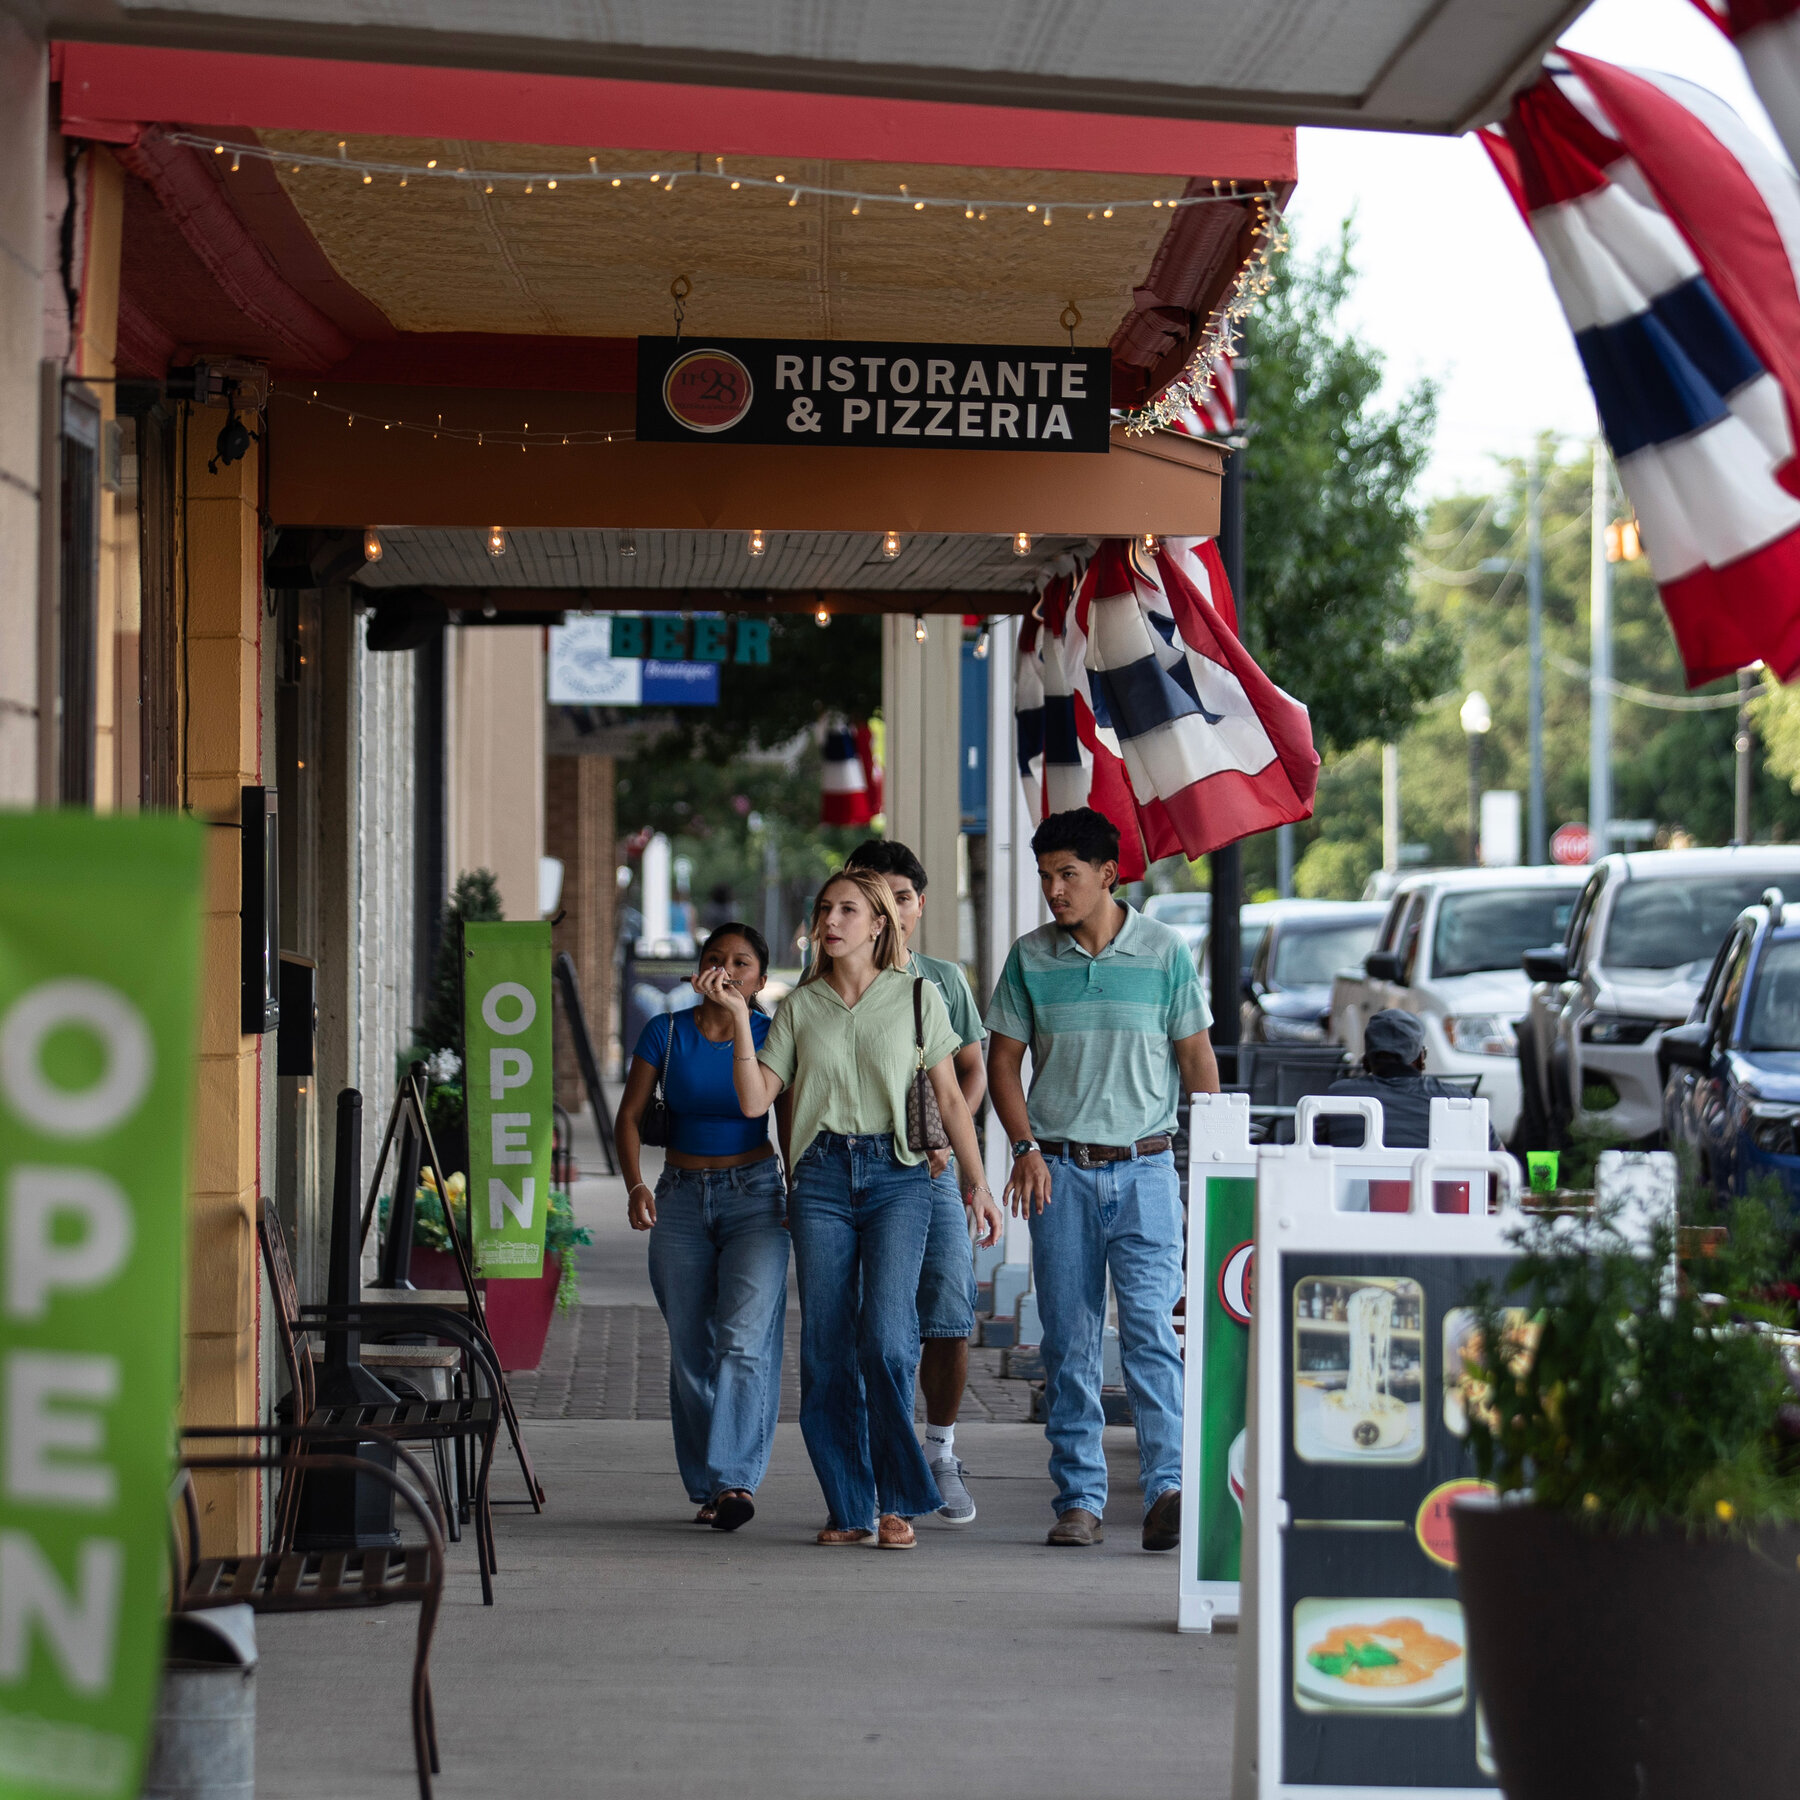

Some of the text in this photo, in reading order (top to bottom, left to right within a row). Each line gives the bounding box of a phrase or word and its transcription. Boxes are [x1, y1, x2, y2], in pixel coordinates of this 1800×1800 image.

[776, 355, 1088, 399] RISTORANTE
[787, 396, 1074, 440] & PIZZERIA
[609, 615, 771, 664] BEER
[481, 981, 537, 1230] OPEN
[0, 977, 157, 1697] OPEN
